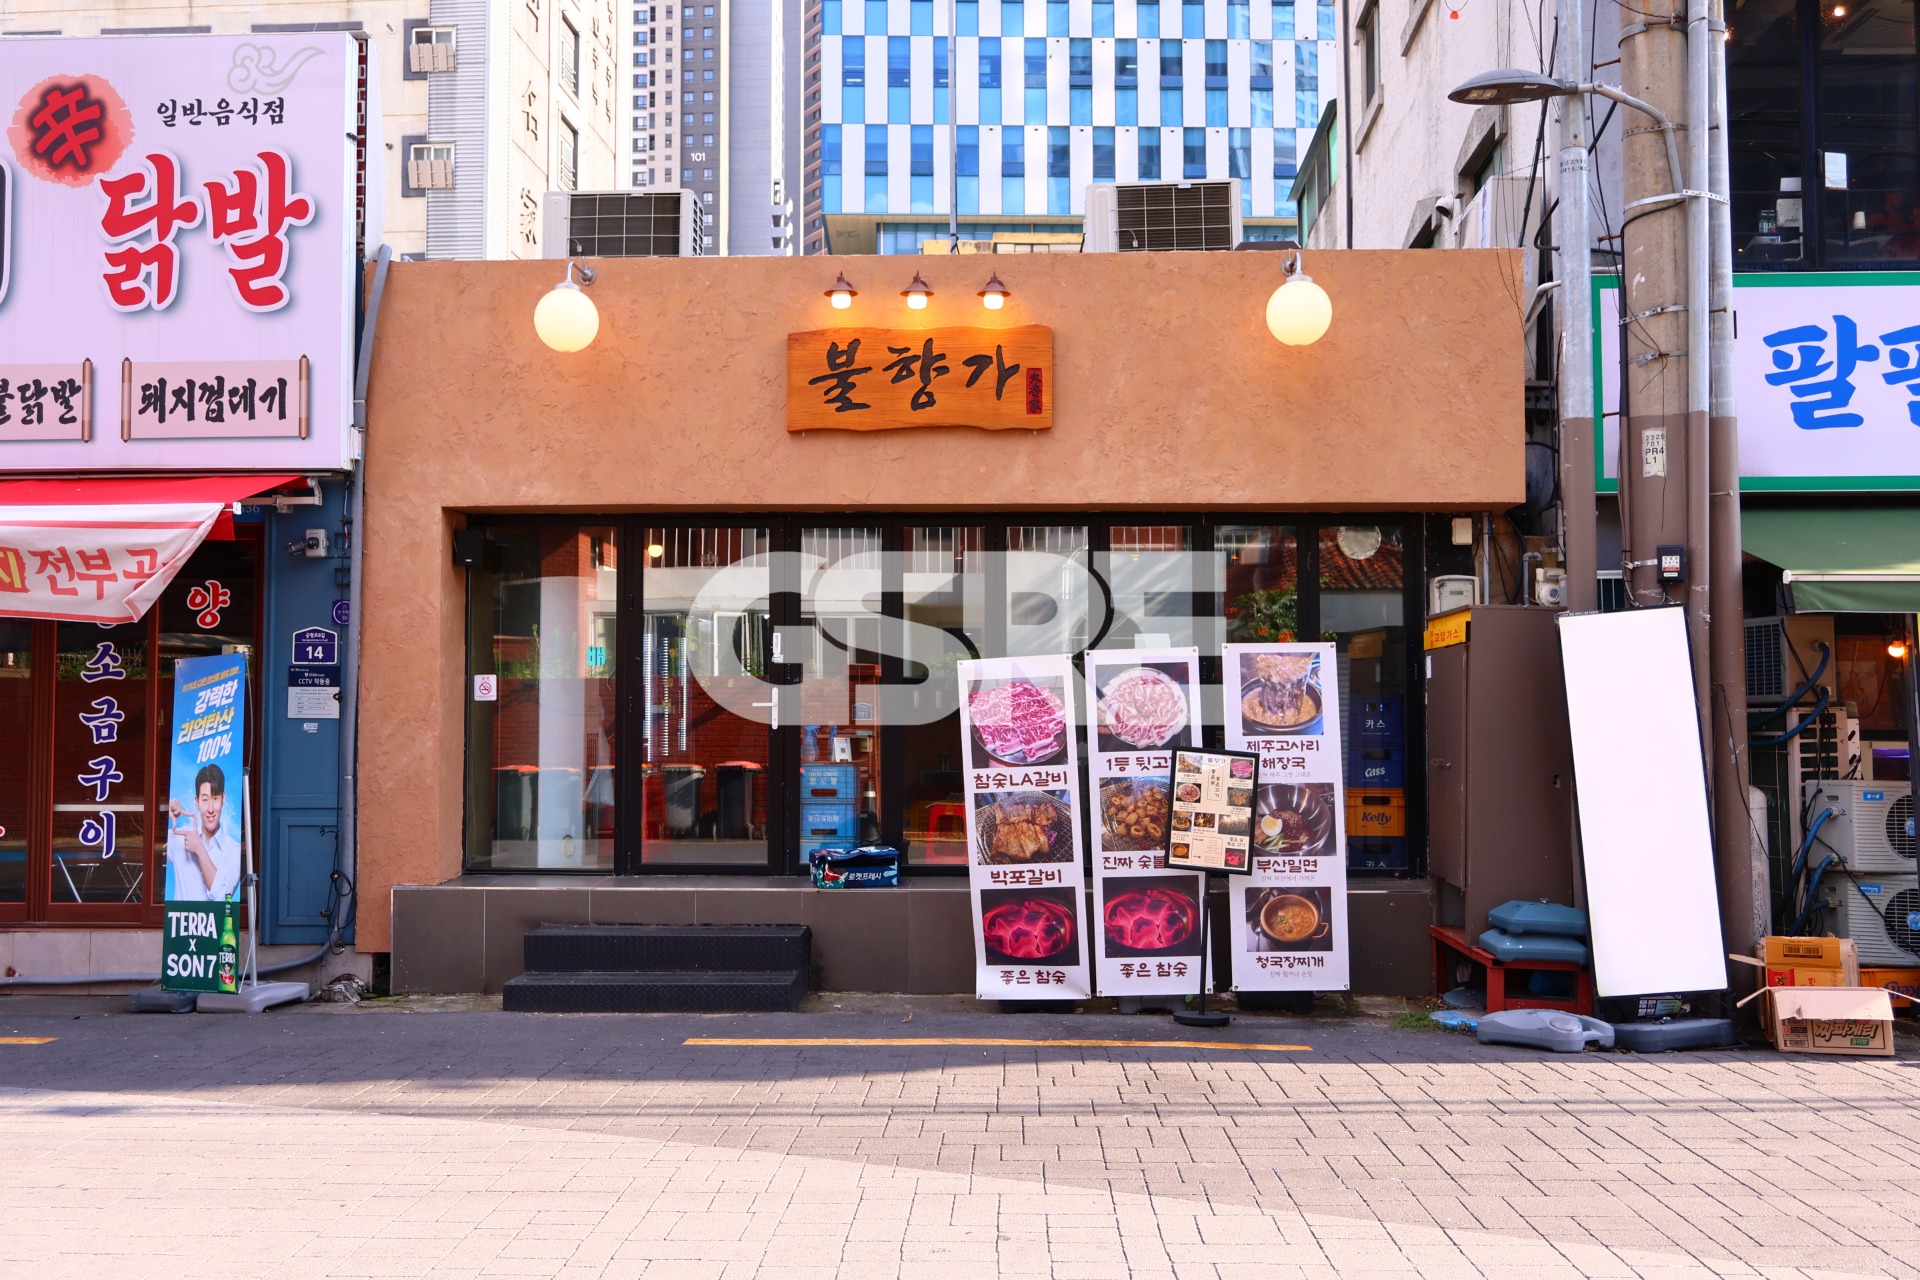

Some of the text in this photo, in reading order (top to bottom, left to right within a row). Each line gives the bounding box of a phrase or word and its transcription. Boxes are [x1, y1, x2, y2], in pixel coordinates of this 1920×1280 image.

[156, 97, 285, 127] 일반음식점
[690, 152, 706, 162] 101
[100, 151, 310, 306] 닭발
[808, 338, 1020, 412] 불향가
[138, 376, 288, 423] 돼지껍데기
[1645, 447, 1665, 455] PR4
[187, 580, 230, 629] 양
[1434, 629, 1459, 642] 고압가스
[305, 645, 324, 659] 14
[194, 679, 239, 715] 강력한
[176, 706, 235, 746] 리얼탄산
[1365, 719, 1386, 729] 카스
[78, 622, 125, 859] 소금구이
[196, 732, 233, 764] 100%
[1246, 739, 1320, 753] 제주고사리
[1106, 756, 1172, 772] 1등 뒷고
[1261, 757, 1306, 770] 해장국
[973, 771, 1068, 789] 참숯LA갈비
[1365, 767, 1386, 778] Cass
[1361, 812, 1392, 825] Kelly
[1102, 856, 1133, 870] 진짜
[1257, 859, 1318, 873] 부산밀면
[847, 871, 882, 880] 로켓프레시
[990, 869, 1062, 885] 박포갈비
[168, 911, 218, 939] TERRA
[188, 938, 197, 952] X
[1119, 961, 1188, 978] 좋은 참숯
[1255, 955, 1324, 969] 청국장찌개
[1000, 969, 1066, 985] 좋은 참숯
[1814, 1021, 1880, 1042] 짜파게티
